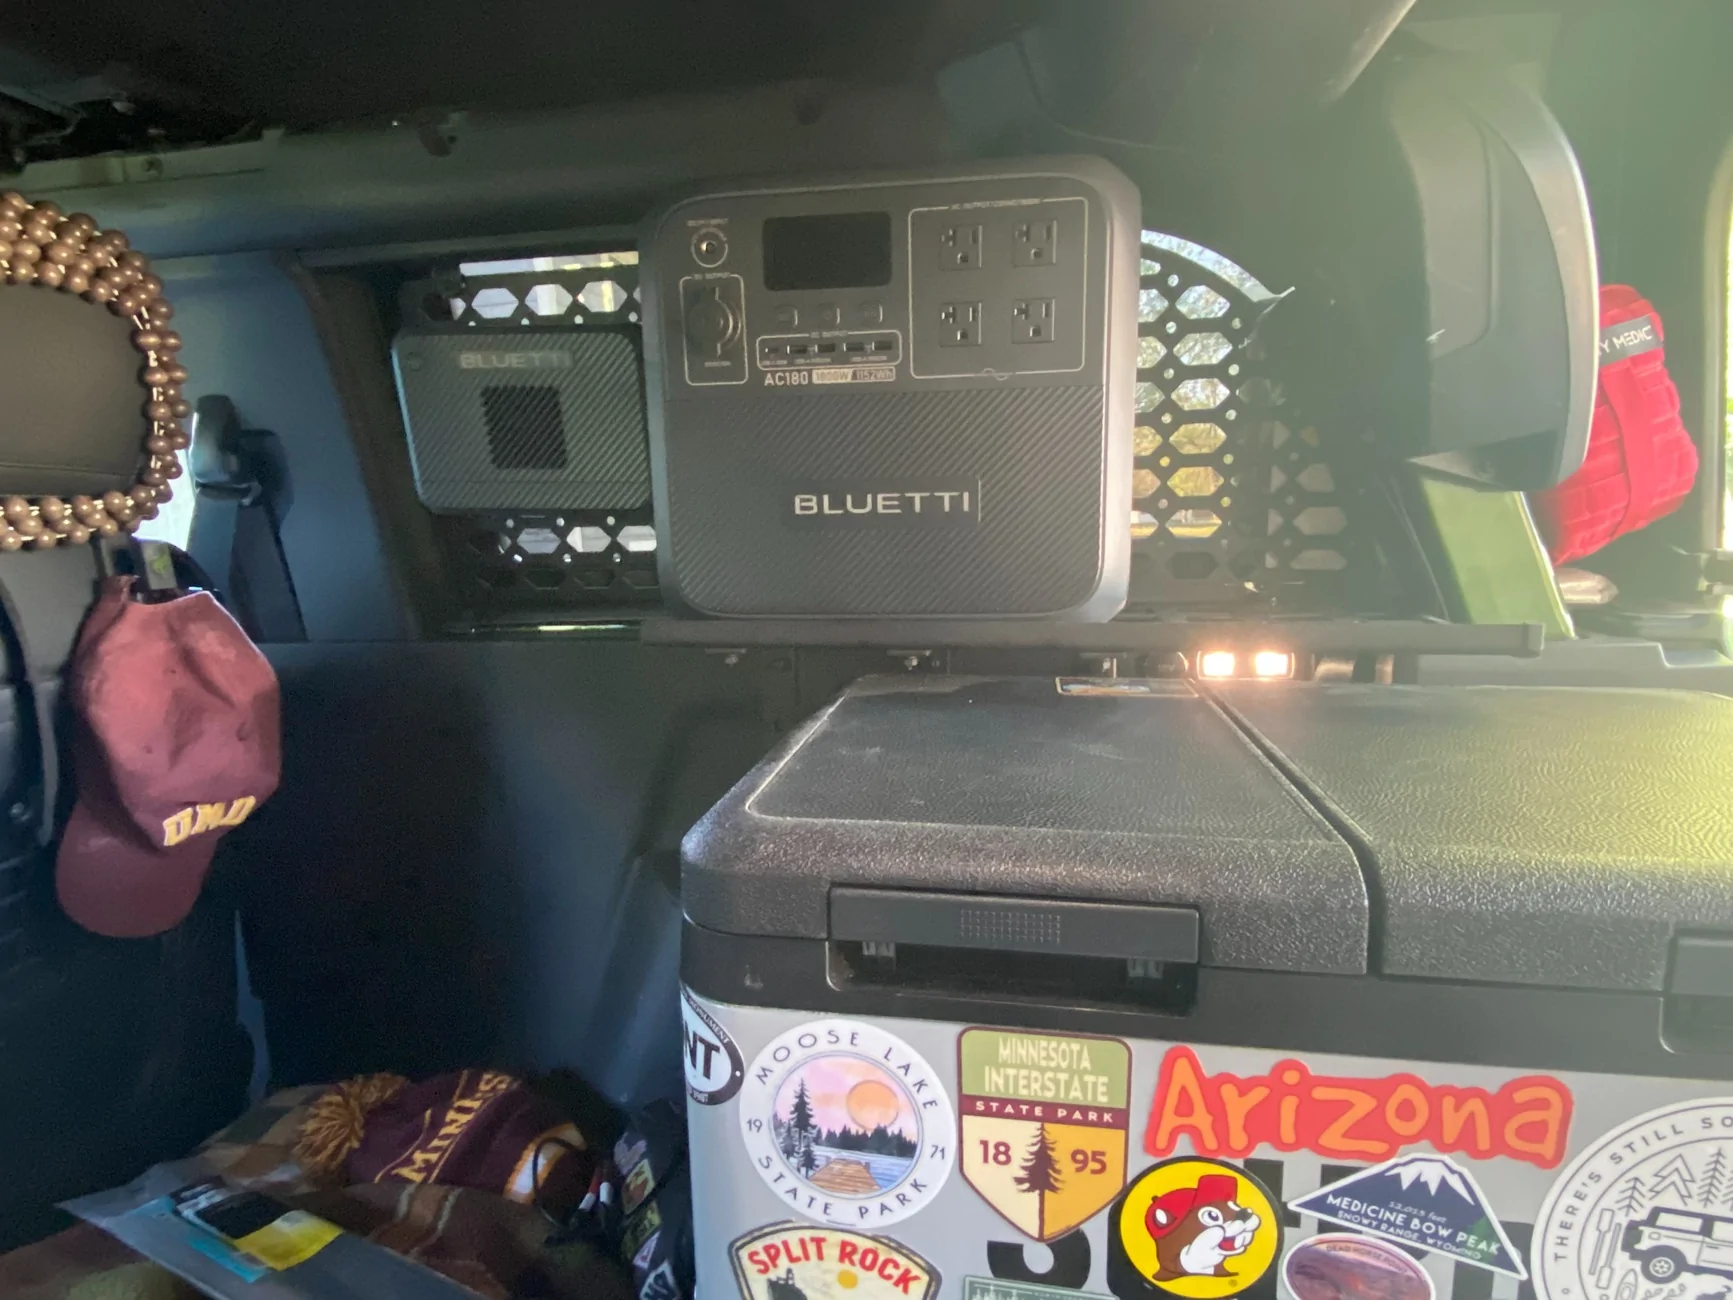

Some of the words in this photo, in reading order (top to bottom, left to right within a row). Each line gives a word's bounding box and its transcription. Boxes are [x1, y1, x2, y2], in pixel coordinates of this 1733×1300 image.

[1612, 325, 1653, 350] MEDIC
[460, 352, 571, 370] BLUETTI
[764, 371, 809, 386] AC180
[794, 491, 970, 515] BLUETTI
[163, 795, 256, 847] UMD
[756, 1029, 860, 1086] MOOSE
[883, 1046, 938, 1109] LAKE
[998, 1037, 1092, 1071] MINNESOTA
[984, 1065, 1109, 1102] INTERSTATE
[975, 1101, 1044, 1117] STATE
[1057, 1108, 1114, 1123] PARK
[1152, 1053, 1567, 1163] Arizona
[746, 1117, 763, 1134] 19
[929, 1144, 945, 1160] 71
[979, 1139, 1013, 1166] 18
[1070, 1148, 1108, 1175] 95
[758, 1154, 833, 1216] STATE
[858, 1178, 928, 1220] PARK
[1553, 1171, 1603, 1262] THERE'S
[1609, 1123, 1684, 1165] STILL
[1326, 1193, 1406, 1226] MEDICINE
[1409, 1217, 1453, 1238] BOW
[1455, 1230, 1502, 1256] PEAK
[1337, 1210, 1378, 1229] SNOWY
[1426, 1236, 1482, 1260] WYOMING
[747, 1236, 828, 1275] SPLIT
[837, 1239, 922, 1295] ROCK
